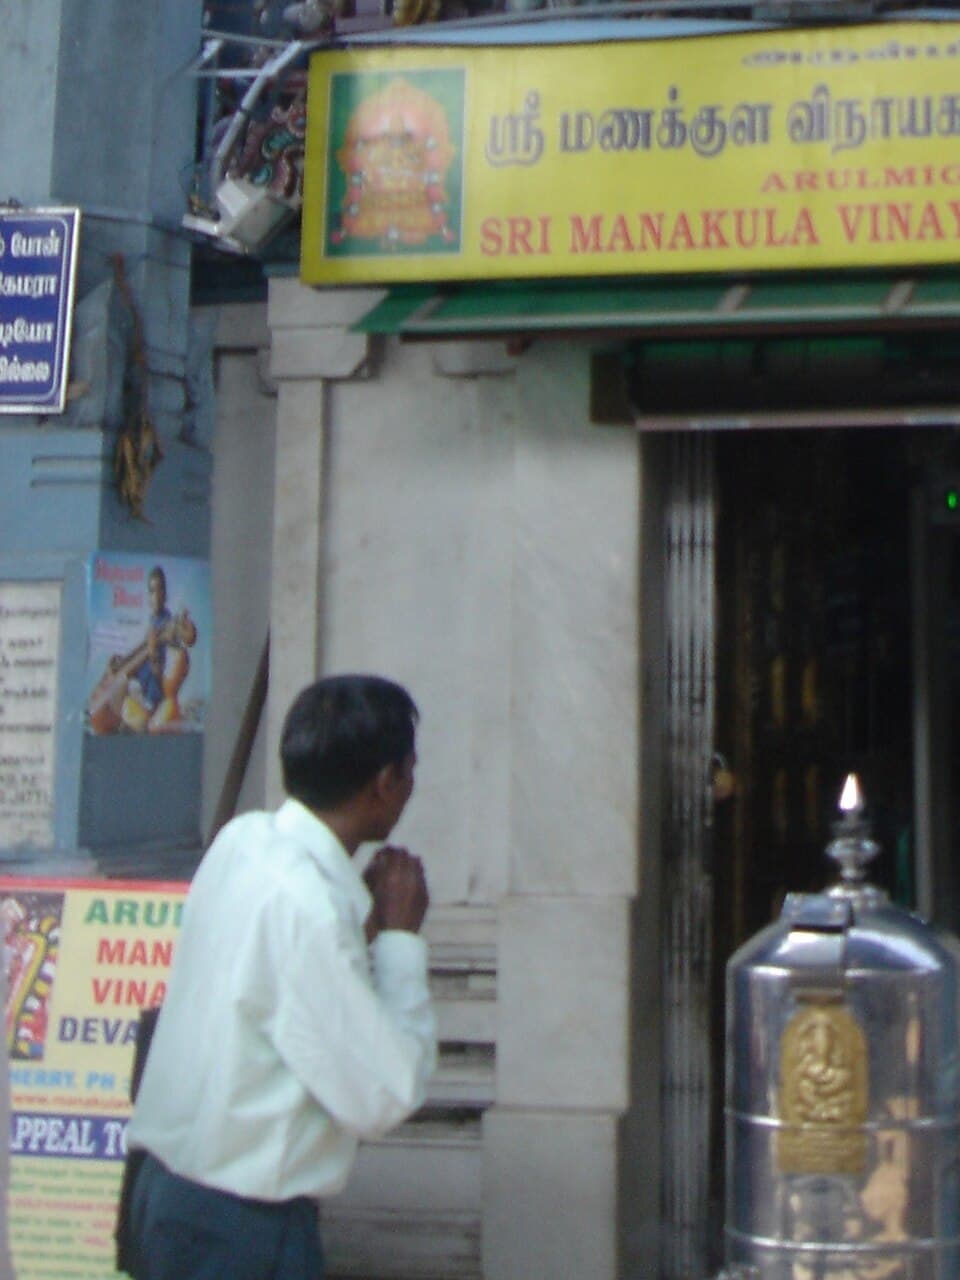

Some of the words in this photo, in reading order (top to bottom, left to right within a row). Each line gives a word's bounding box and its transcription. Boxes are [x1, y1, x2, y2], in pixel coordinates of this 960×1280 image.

[480, 217, 552, 257] SRI
[569, 207, 820, 254] MANAKULA
[10, 1116, 96, 1155] PPEAL
